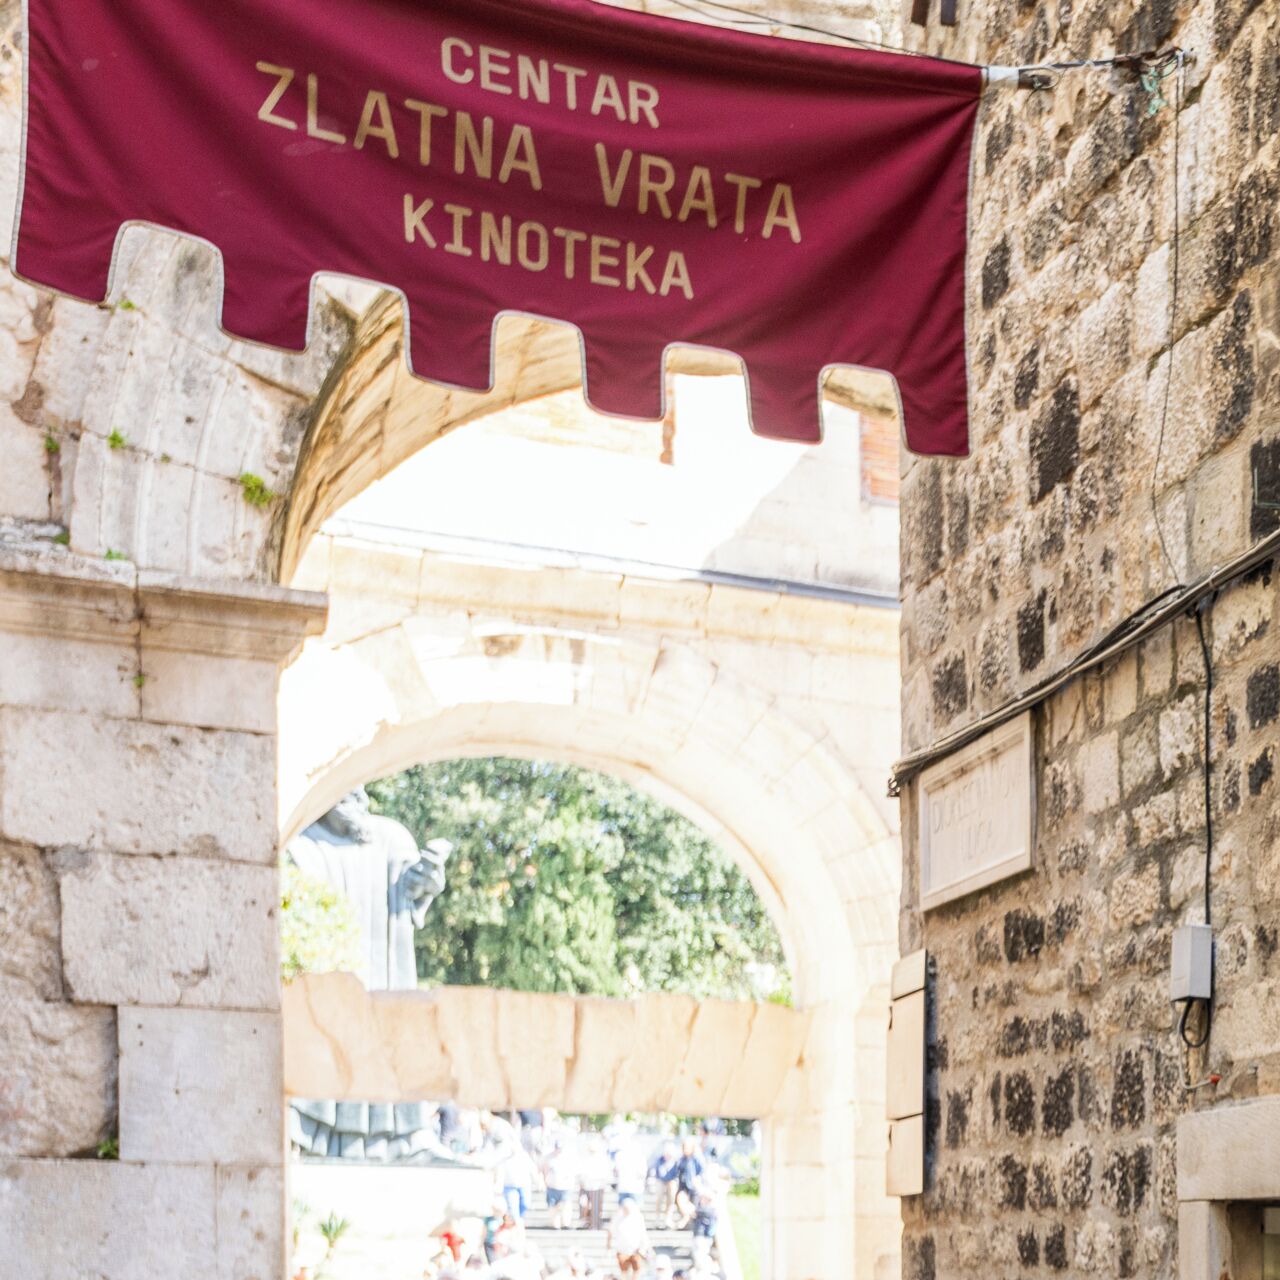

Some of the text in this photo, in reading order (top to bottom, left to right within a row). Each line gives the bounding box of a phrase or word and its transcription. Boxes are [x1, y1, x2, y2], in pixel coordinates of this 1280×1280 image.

[441, 36, 660, 128] CENTAR
[256, 61, 802, 243] ZLATNA VRATA
[402, 194, 694, 299] KINOTEKA
